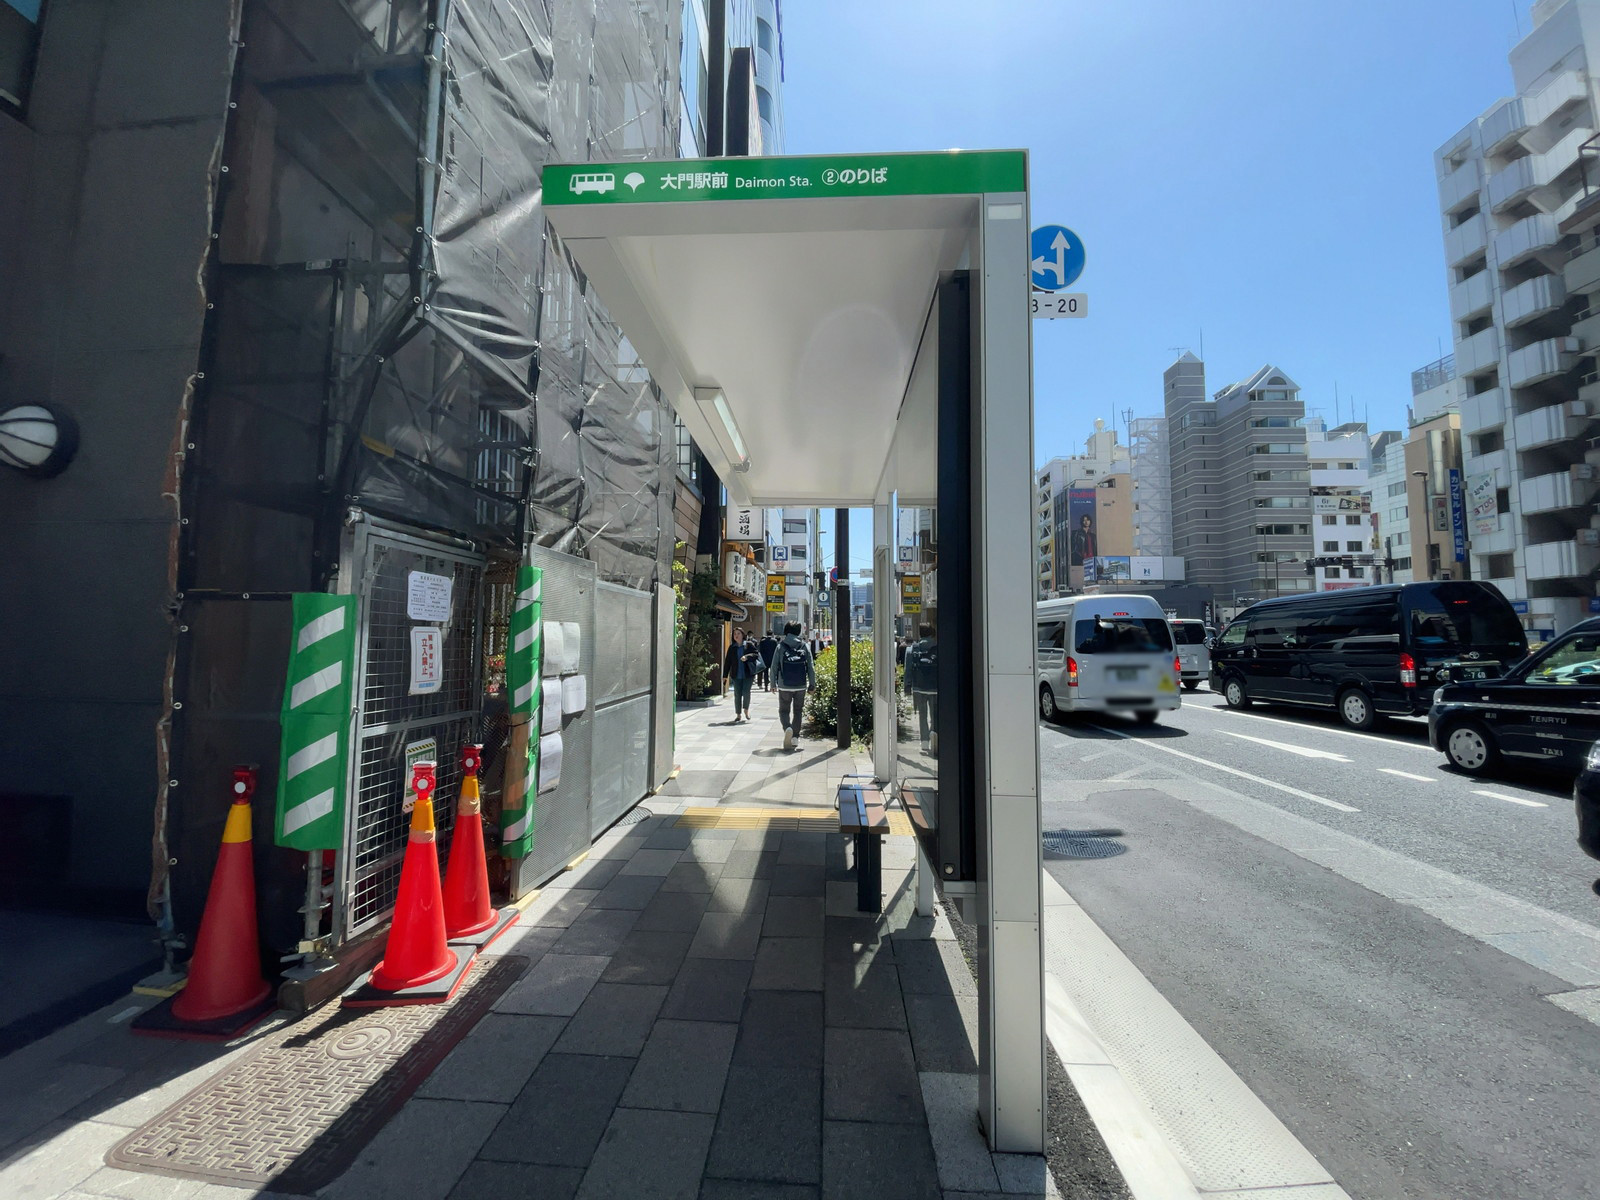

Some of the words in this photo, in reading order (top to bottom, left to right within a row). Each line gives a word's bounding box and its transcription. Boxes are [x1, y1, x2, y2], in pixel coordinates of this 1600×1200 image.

[660, 172, 729, 190] 大門駅前
[735, 176, 785, 189] Daimon
[789, 175, 813, 187] Sta.
[1530, 715, 1568, 724] TENRYU
[1541, 747, 1564, 757] TAXI
